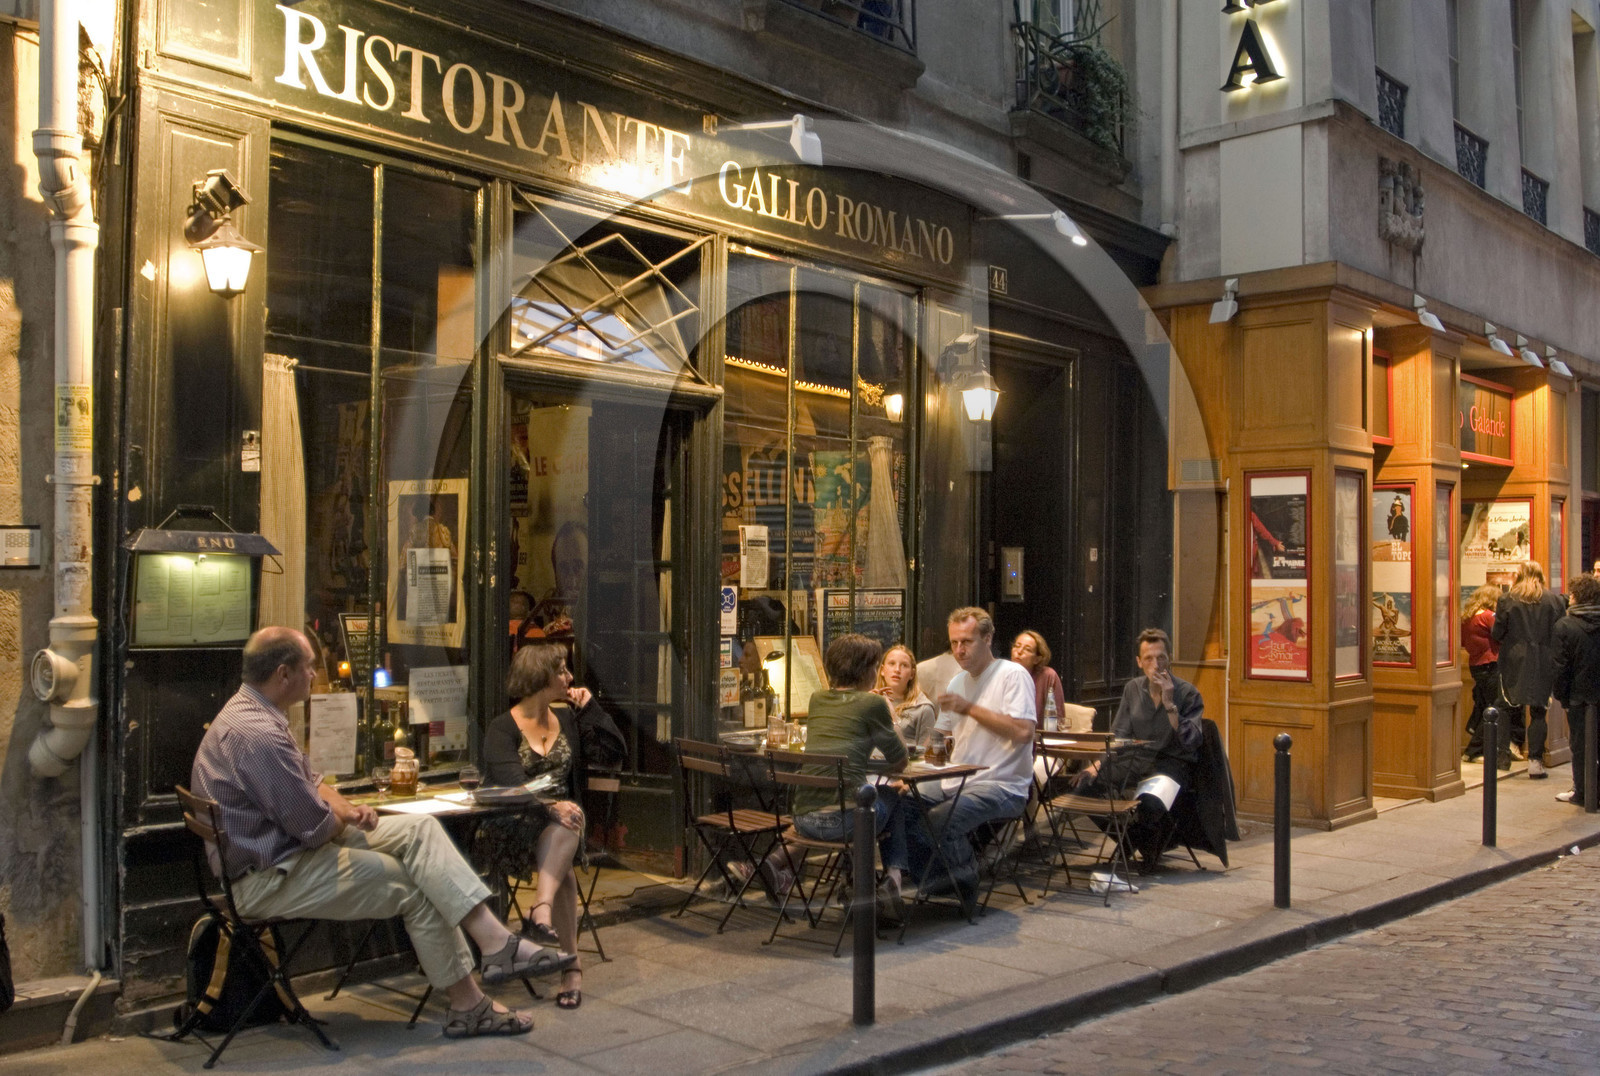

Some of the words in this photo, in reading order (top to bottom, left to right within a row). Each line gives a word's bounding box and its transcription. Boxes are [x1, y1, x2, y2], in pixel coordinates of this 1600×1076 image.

[1219, 0, 1286, 93] A
[274, 4, 694, 195] RISTORANTE
[718, 160, 956, 266] GALLO-ROMANO
[992, 270, 1005, 290] 44
[1470, 405, 1506, 437] Galande
[189, 536, 236, 549] ENU
[1391, 541, 1402, 551] EL
